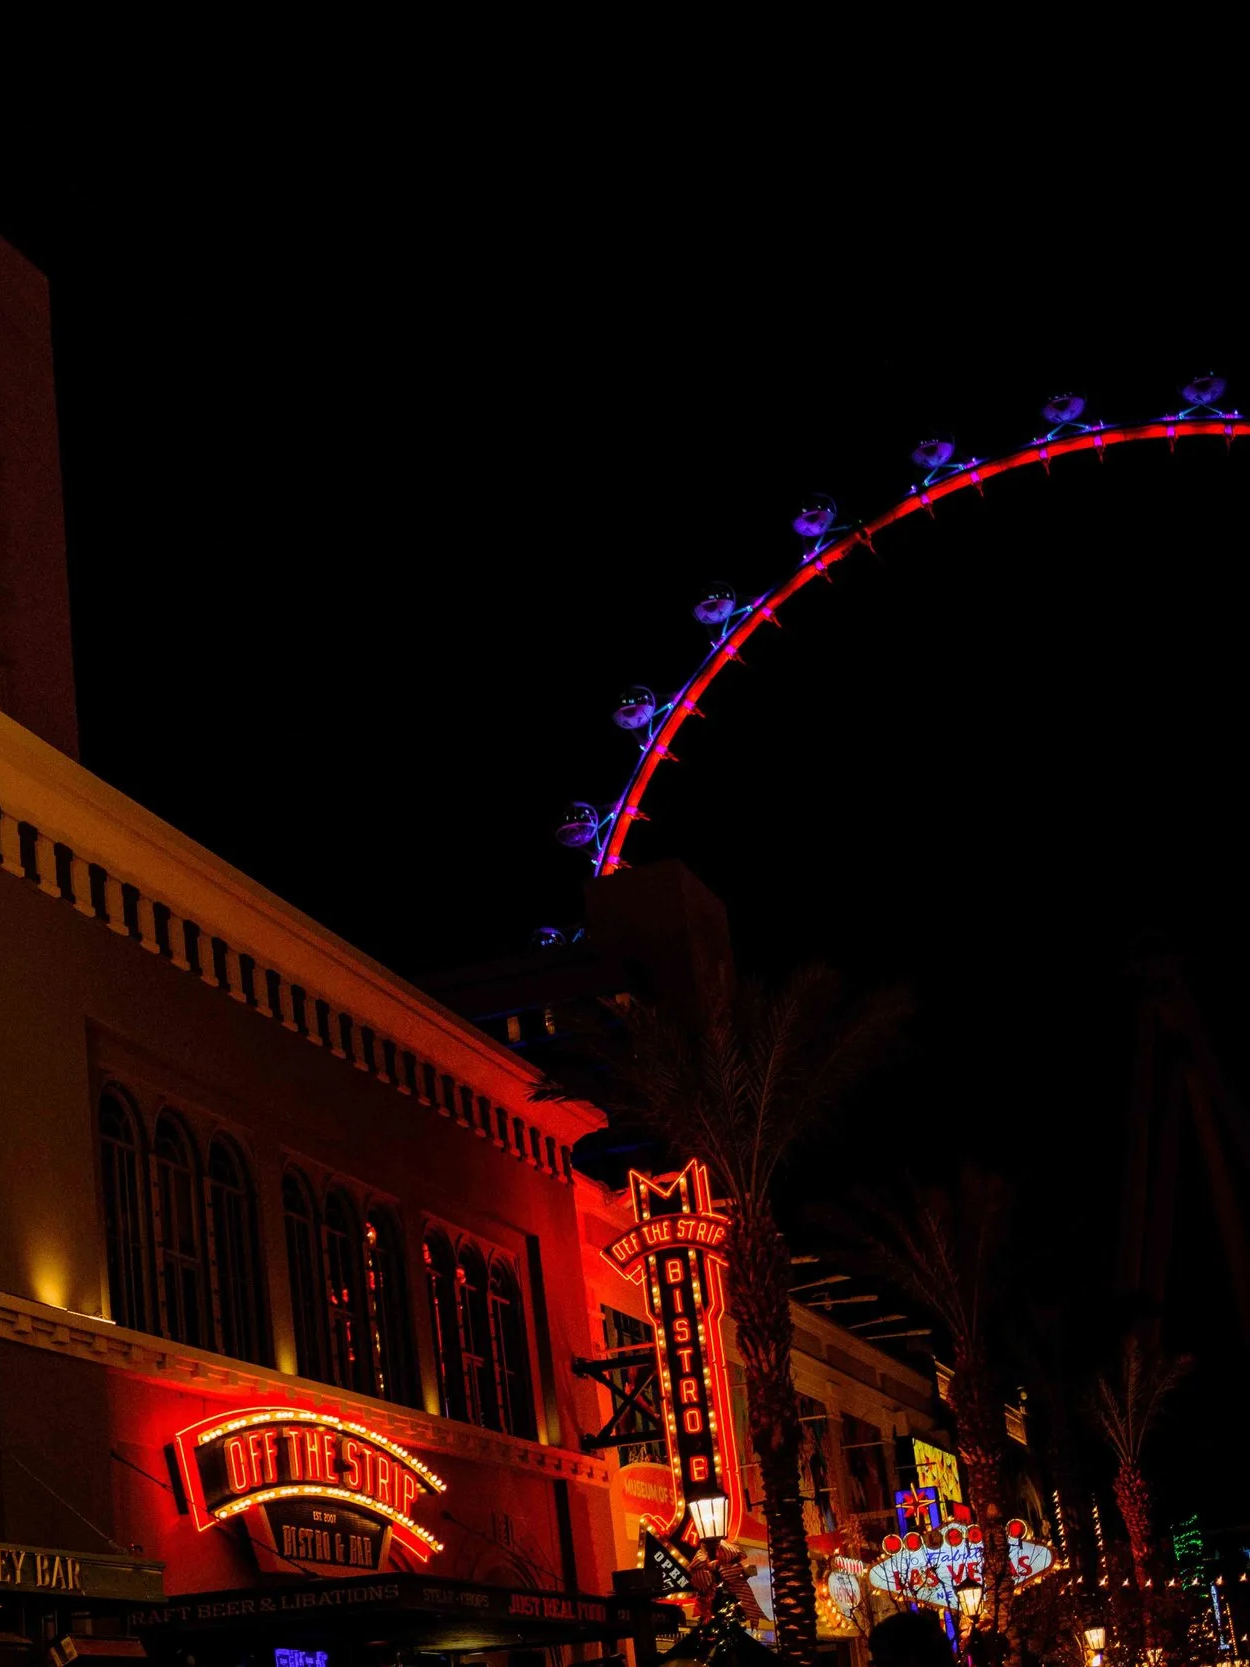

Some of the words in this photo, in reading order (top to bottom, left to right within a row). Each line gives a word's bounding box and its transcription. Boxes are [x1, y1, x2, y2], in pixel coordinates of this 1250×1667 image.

[612, 1232, 639, 1261] OFF
[642, 1221, 671, 1244] THE
[665, 1259, 703, 1434] BISTRO
[224, 1428, 278, 1494] OFF
[283, 1427, 339, 1484] THE
[342, 1437, 419, 1517] STRIP
[624, 1479, 657, 1500] MUSEUM
[282, 1525, 331, 1561] BISTRO
[350, 1535, 373, 1567] BAR
[35, 1552, 85, 1594] BAR
[654, 1551, 689, 1588] OPEN
[893, 1567, 939, 1591] LAS
[947, 1555, 1033, 1585] VES
[132, 1606, 191, 1626] RAFT
[197, 1600, 256, 1619] BEER
[279, 1584, 399, 1610] LIBATIONS
